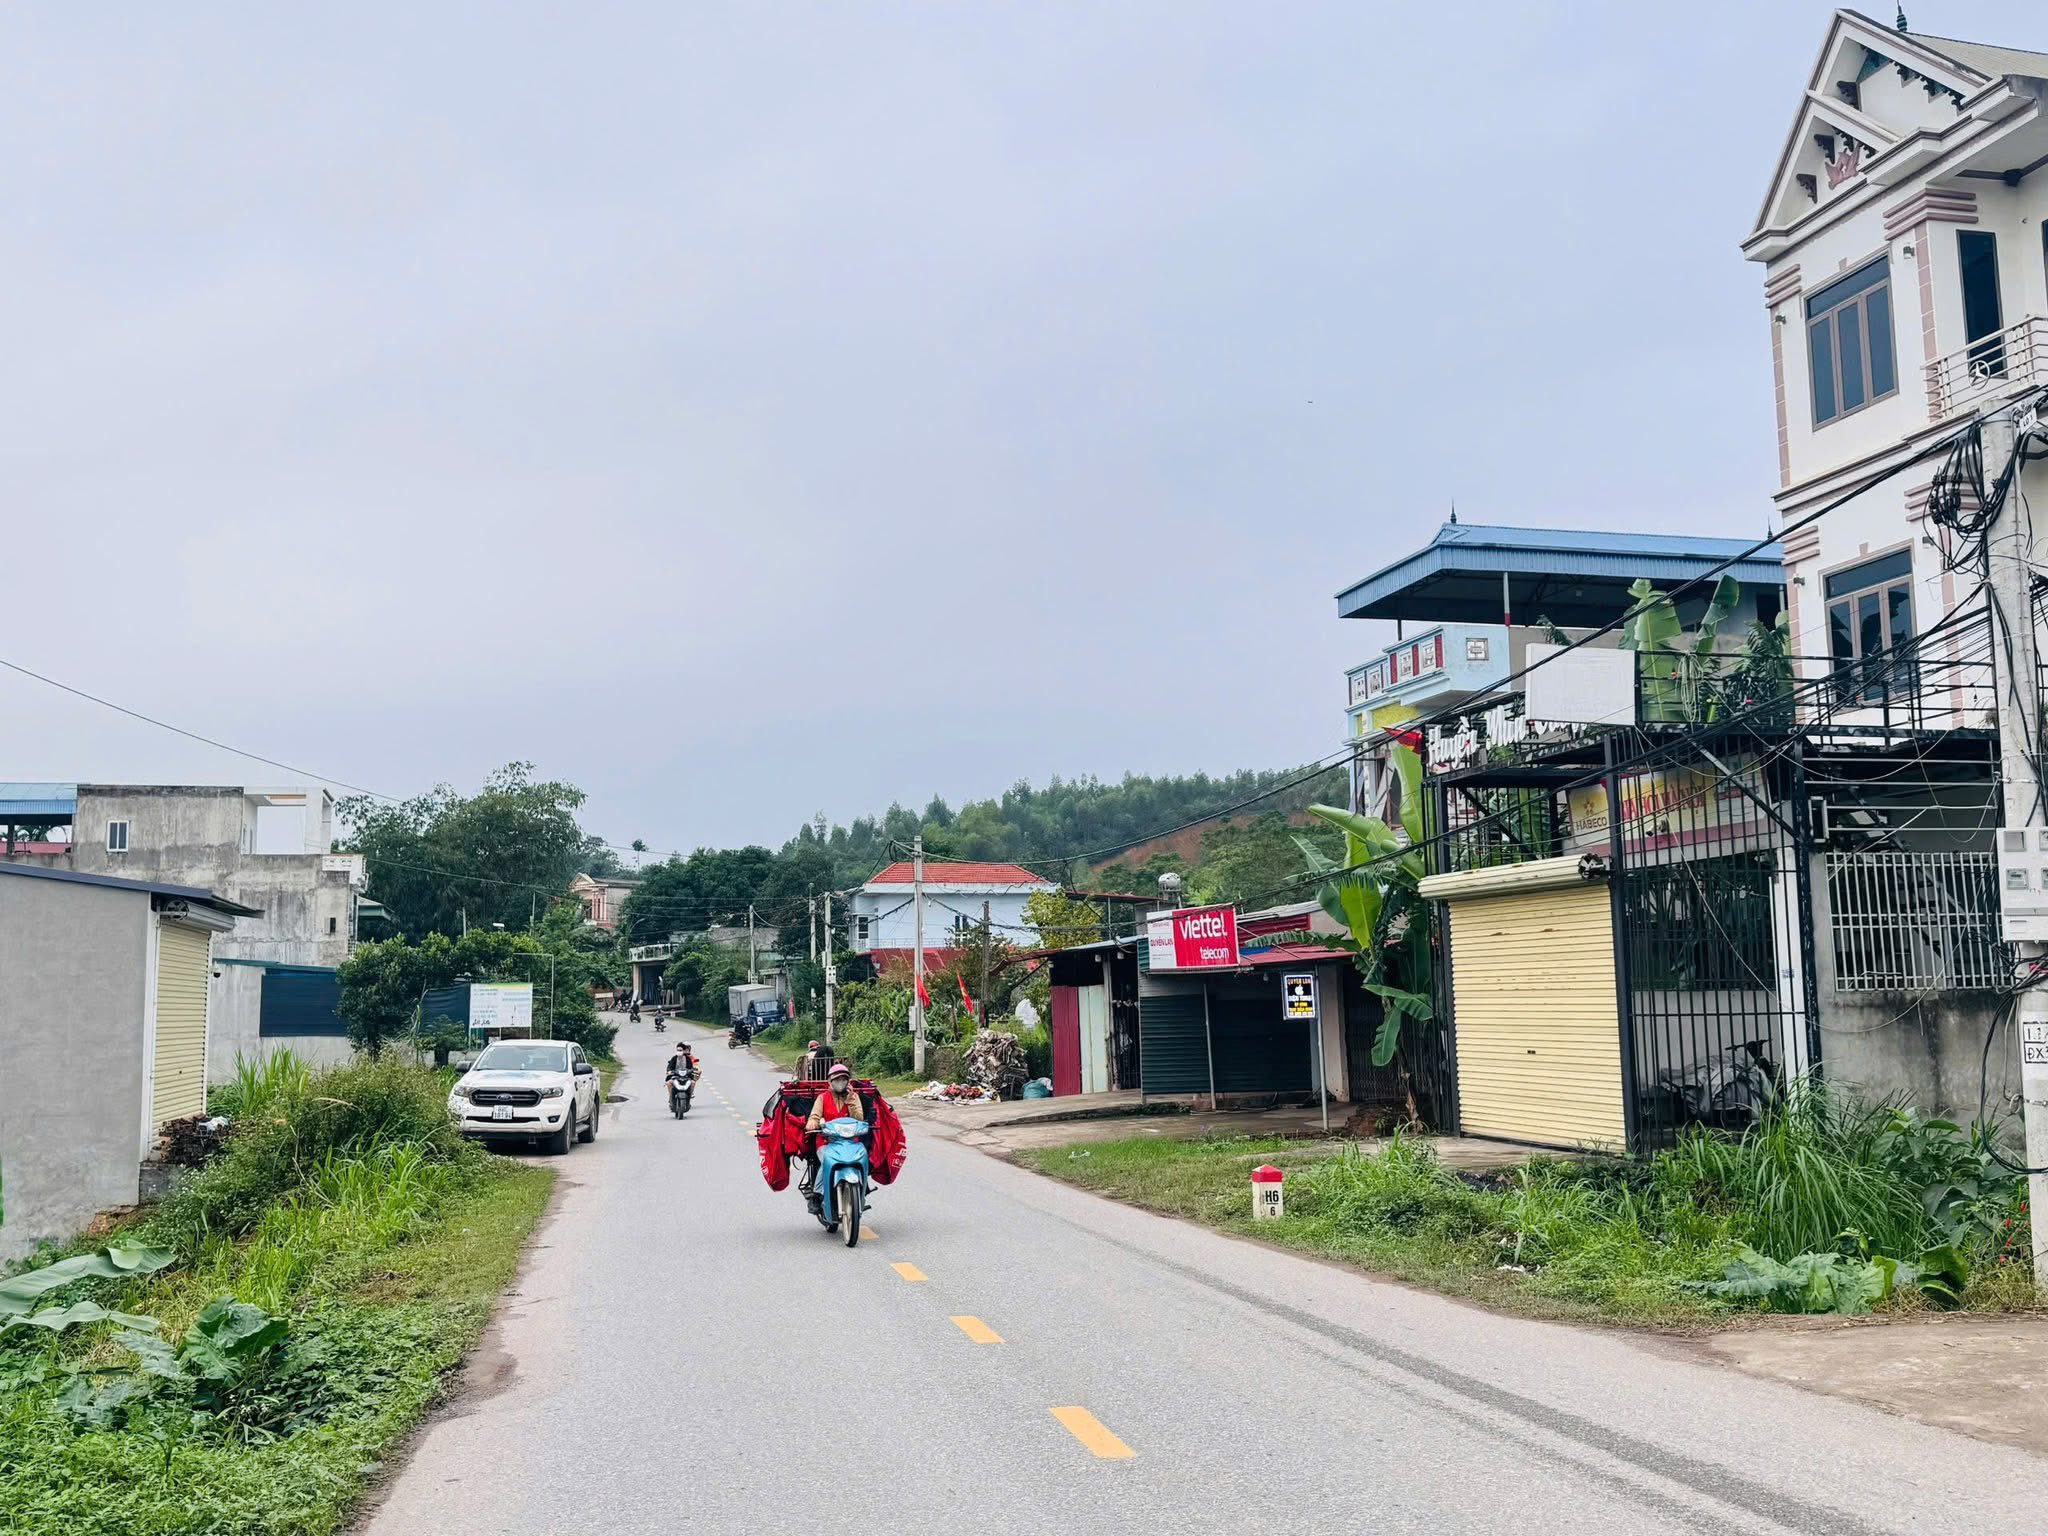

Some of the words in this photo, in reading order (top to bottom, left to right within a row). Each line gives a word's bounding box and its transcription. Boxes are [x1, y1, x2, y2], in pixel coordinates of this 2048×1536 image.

[1575, 816, 1608, 830] HABECO
[1179, 912, 1228, 940] viettel
[1200, 946, 1229, 960] telecom
[1265, 1190, 1279, 1203] H6
[1270, 1206, 1276, 1216] 6
